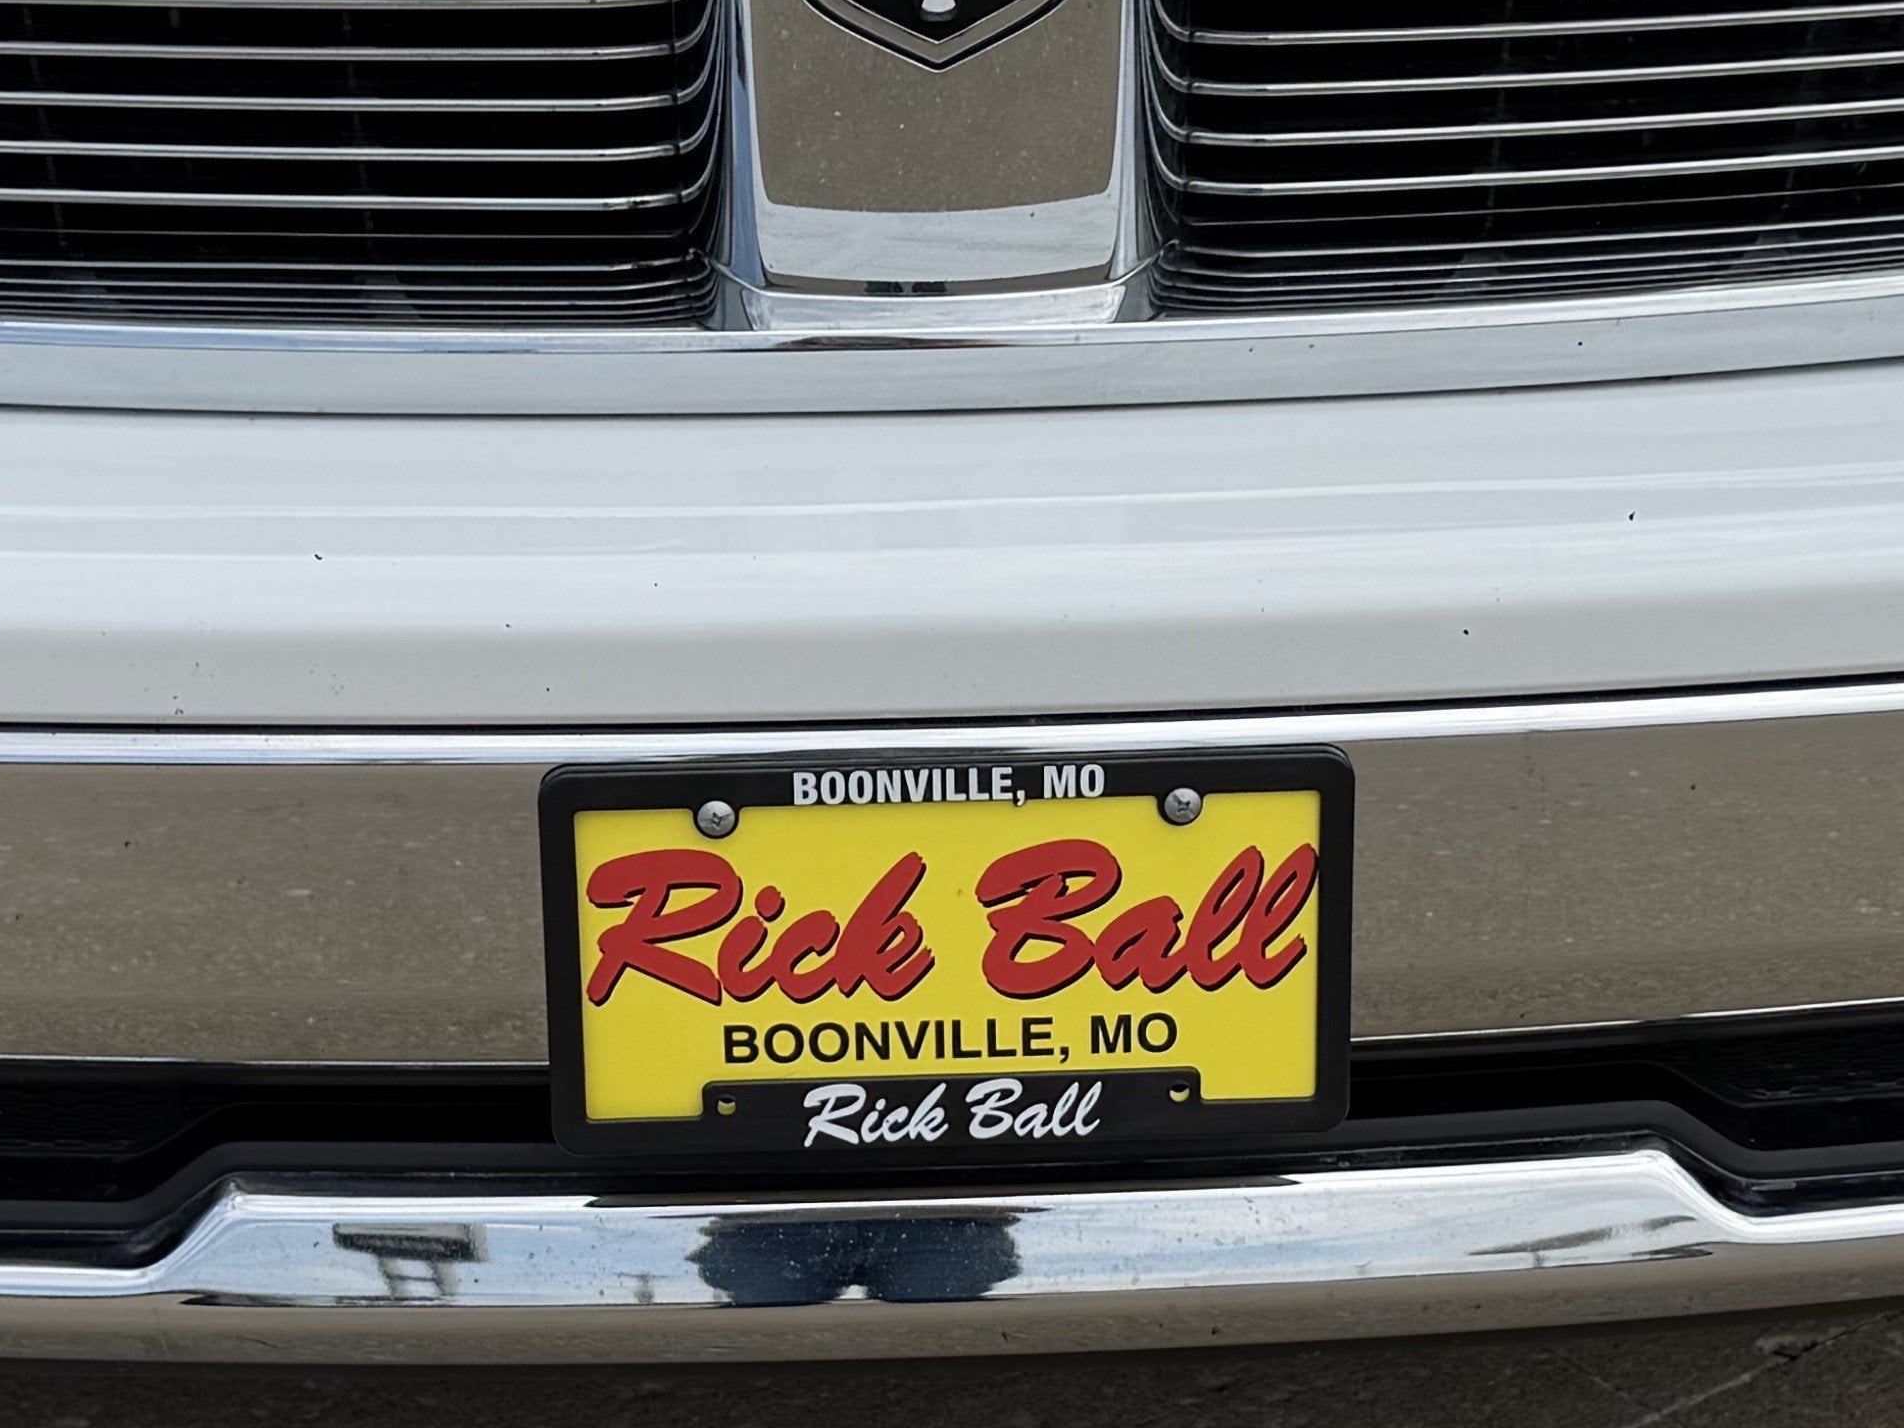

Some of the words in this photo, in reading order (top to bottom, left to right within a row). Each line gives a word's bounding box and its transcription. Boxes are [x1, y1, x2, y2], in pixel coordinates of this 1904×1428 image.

[792, 767, 1026, 807] BOONVILLE,
[1042, 763, 1106, 799] MO
[585, 848, 936, 1007] Rick
[974, 838, 1319, 1000] Ball
[722, 1016, 1071, 1065] BOONVILLE,
[1090, 1012, 1179, 1055] MO
[802, 1082, 950, 1149] Rick
[965, 1078, 1103, 1140] Ball
